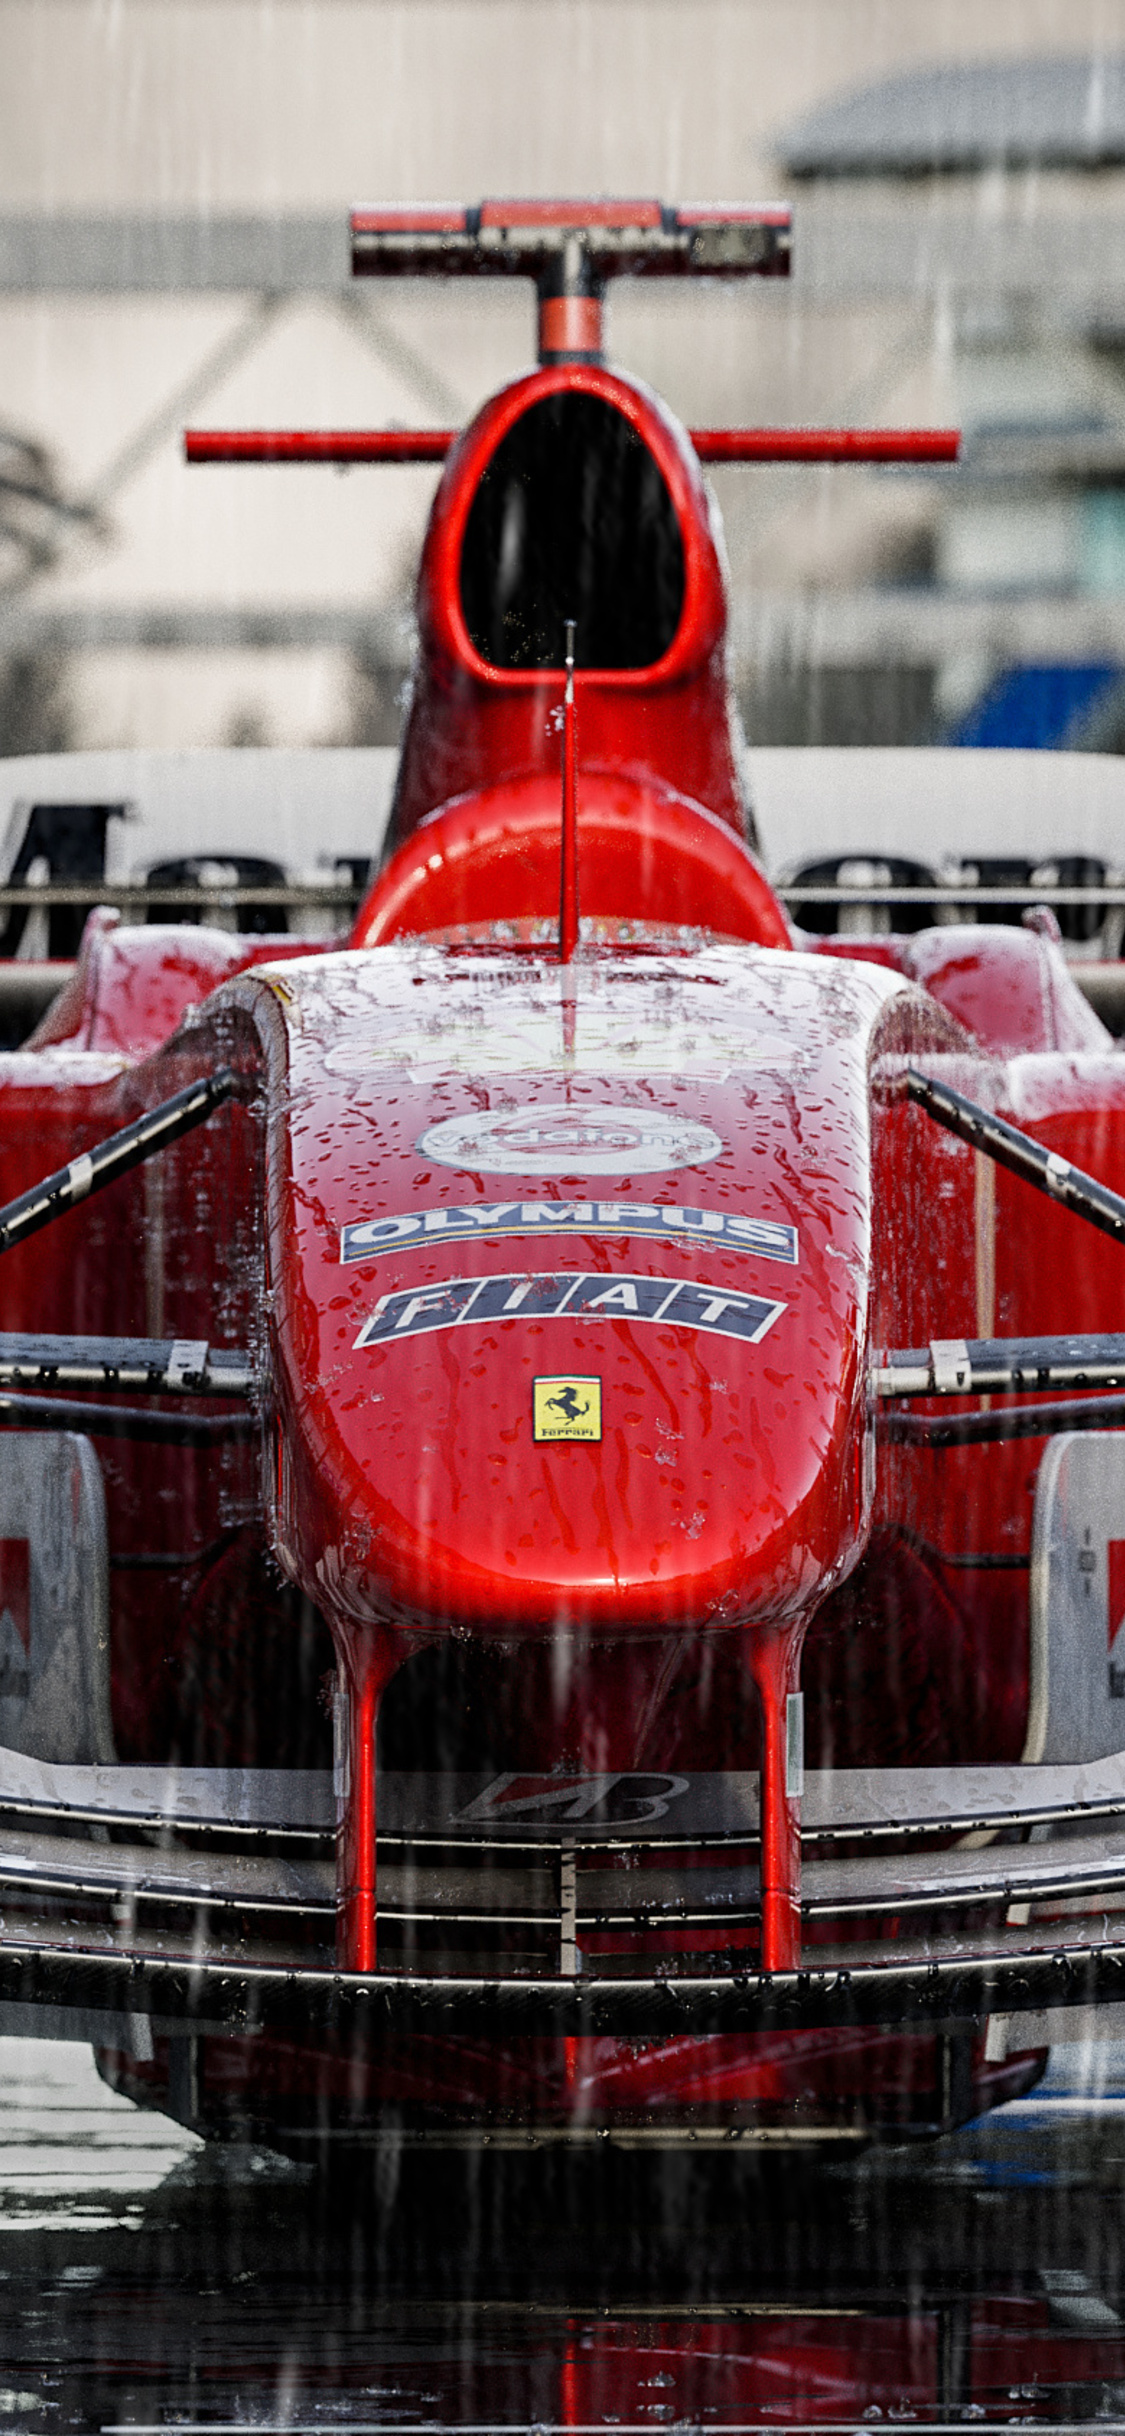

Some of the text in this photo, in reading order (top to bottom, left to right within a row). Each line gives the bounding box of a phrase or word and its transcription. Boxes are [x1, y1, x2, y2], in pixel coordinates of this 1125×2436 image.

[349, 1204, 789, 1246] OLYMPUS
[395, 1282, 750, 1328] FIAT
[541, 1427, 594, 1437] Ferrari
